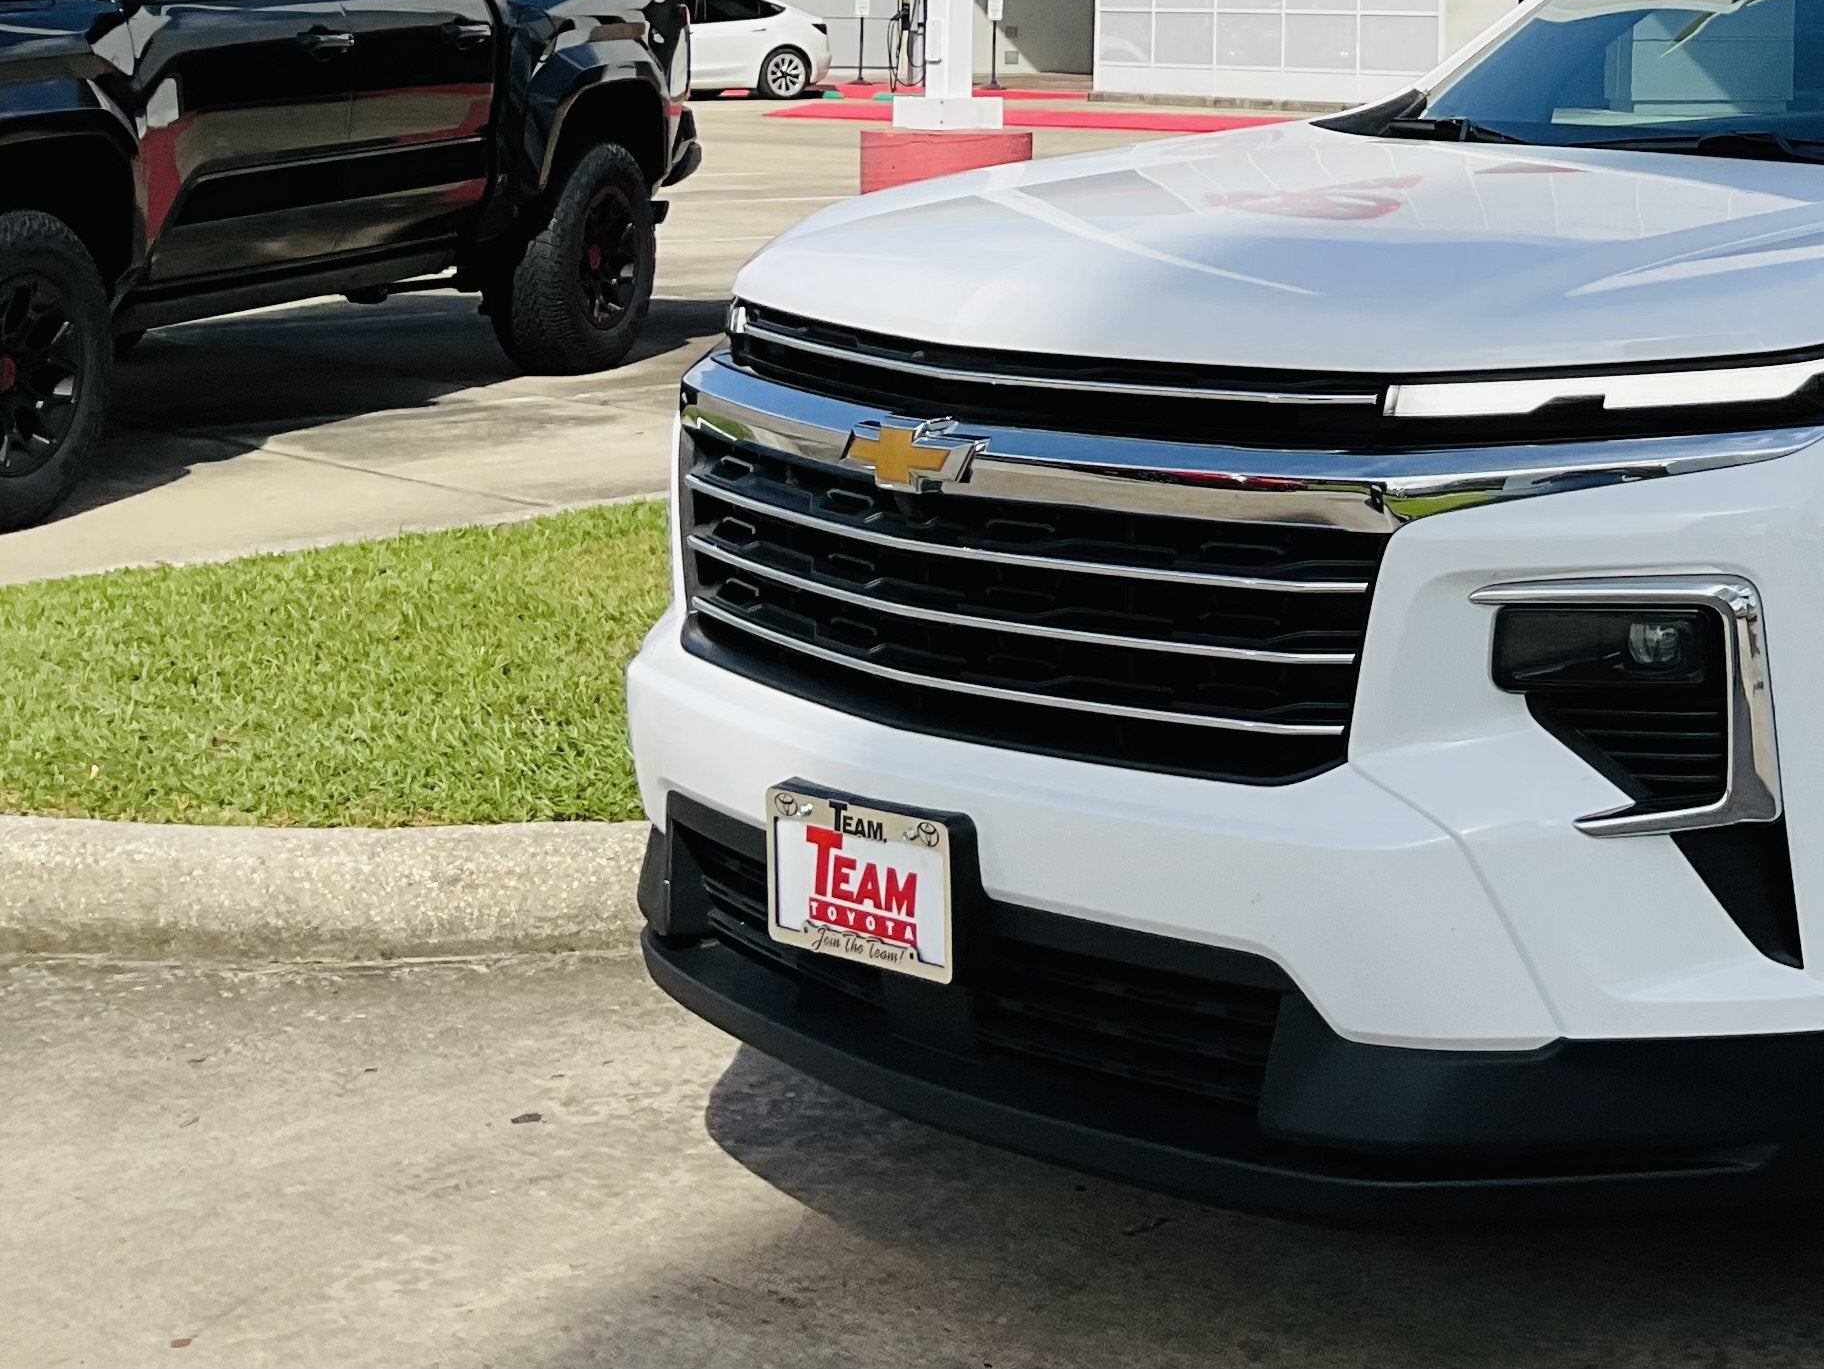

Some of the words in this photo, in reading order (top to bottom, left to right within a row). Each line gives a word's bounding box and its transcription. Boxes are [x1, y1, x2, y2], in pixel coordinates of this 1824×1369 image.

[806, 825, 918, 918] TEAM
[809, 902, 915, 941] TOYOTA
[811, 928, 840, 950] Join
